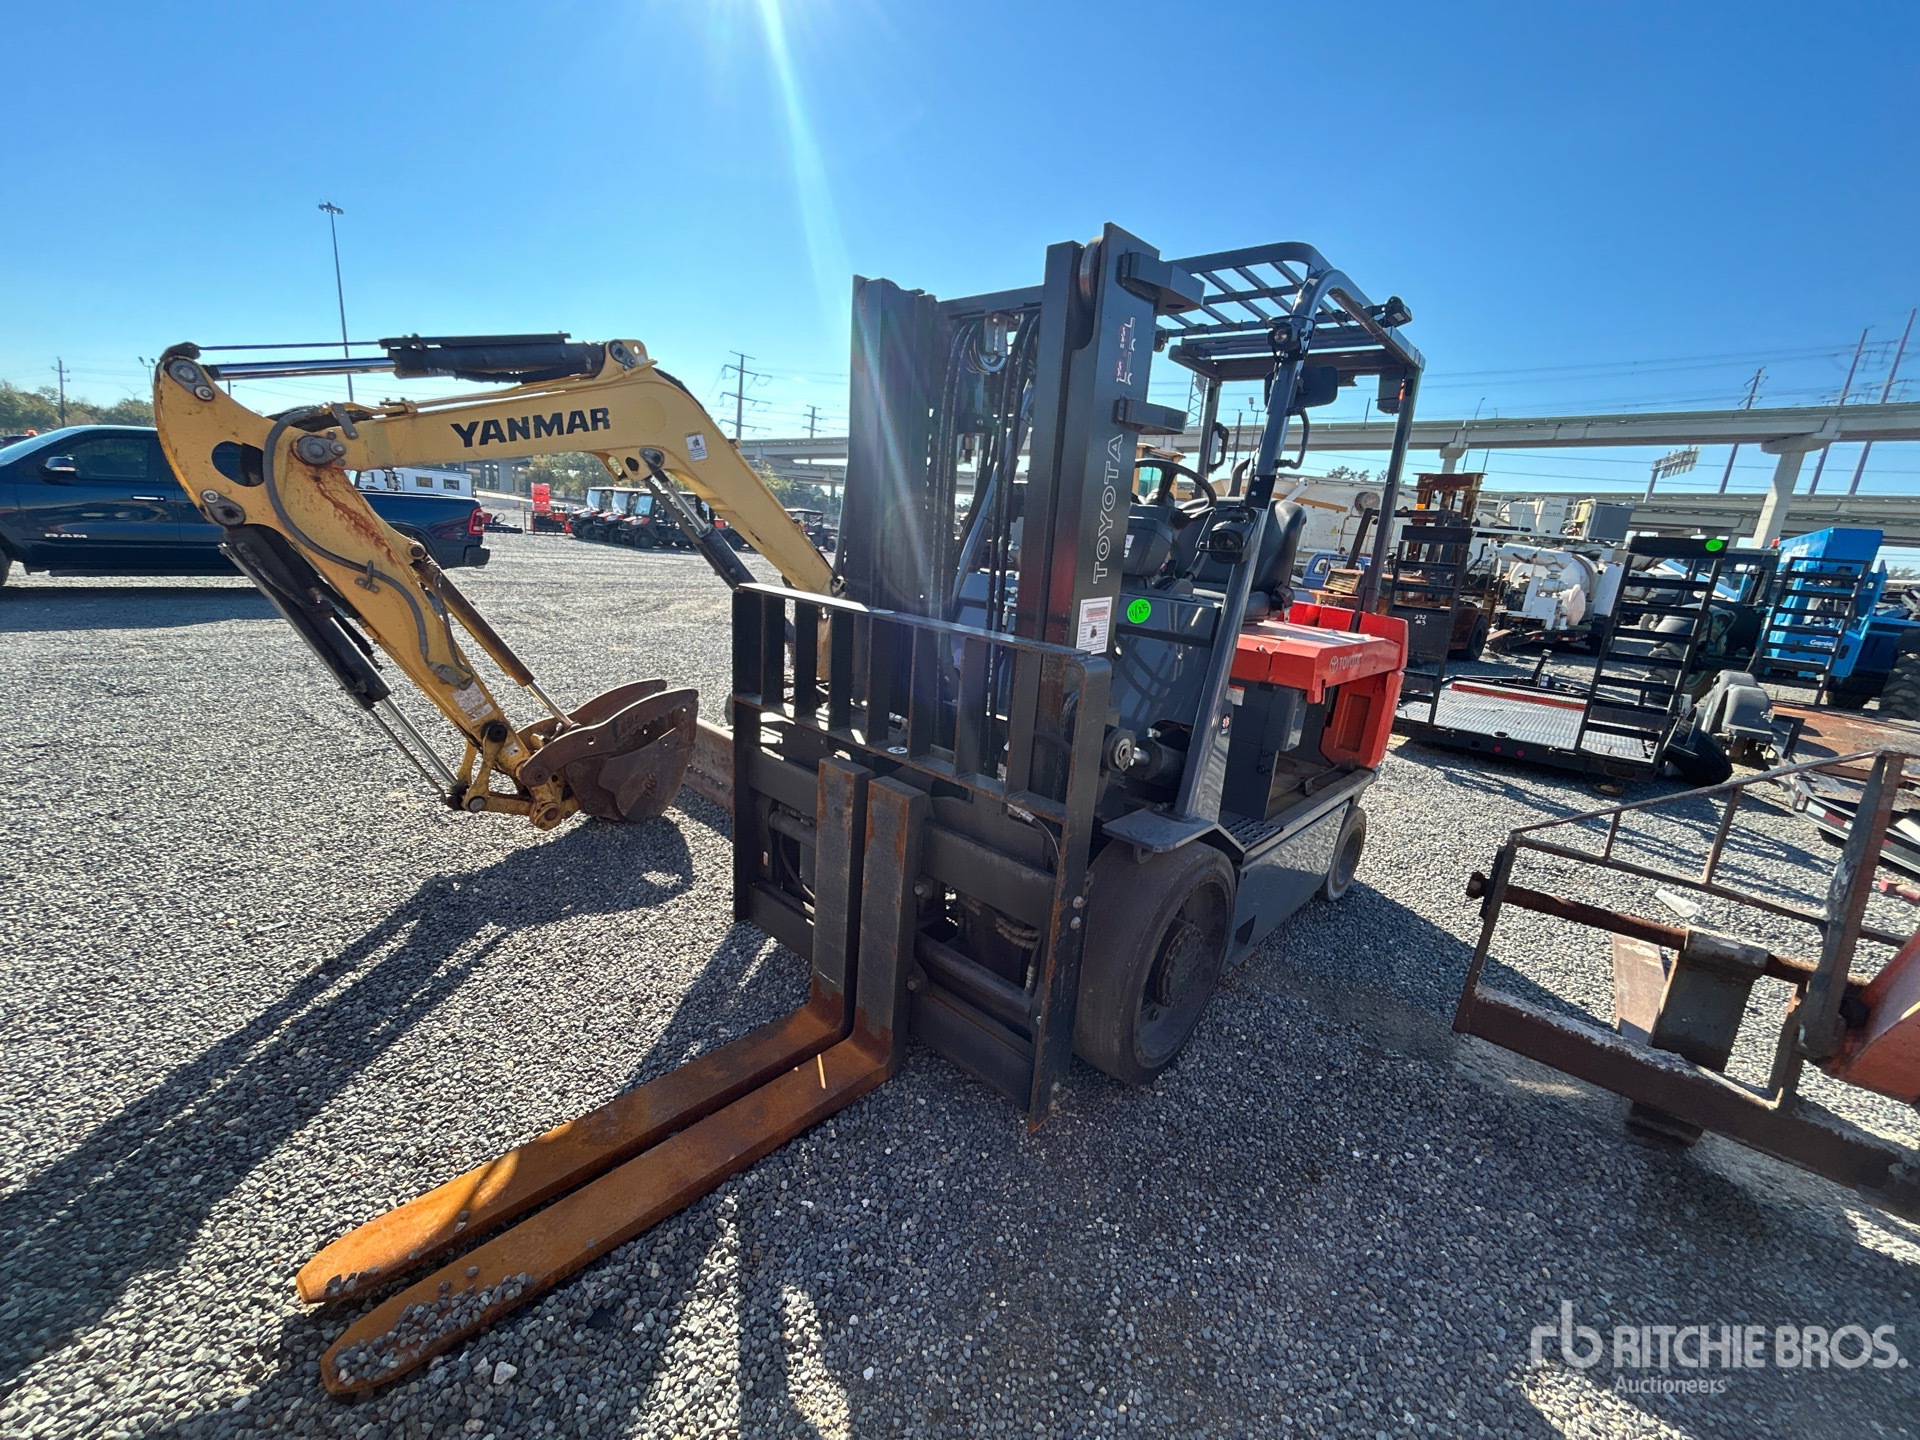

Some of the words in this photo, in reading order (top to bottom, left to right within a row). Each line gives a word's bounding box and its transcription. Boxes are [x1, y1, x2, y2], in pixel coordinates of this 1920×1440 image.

[450, 407, 611, 448] YANMAR
[1092, 433, 1124, 585] TOYOTA
[1809, 639, 1834, 648] Genie
[1339, 652, 1363, 670] TOYOTA
